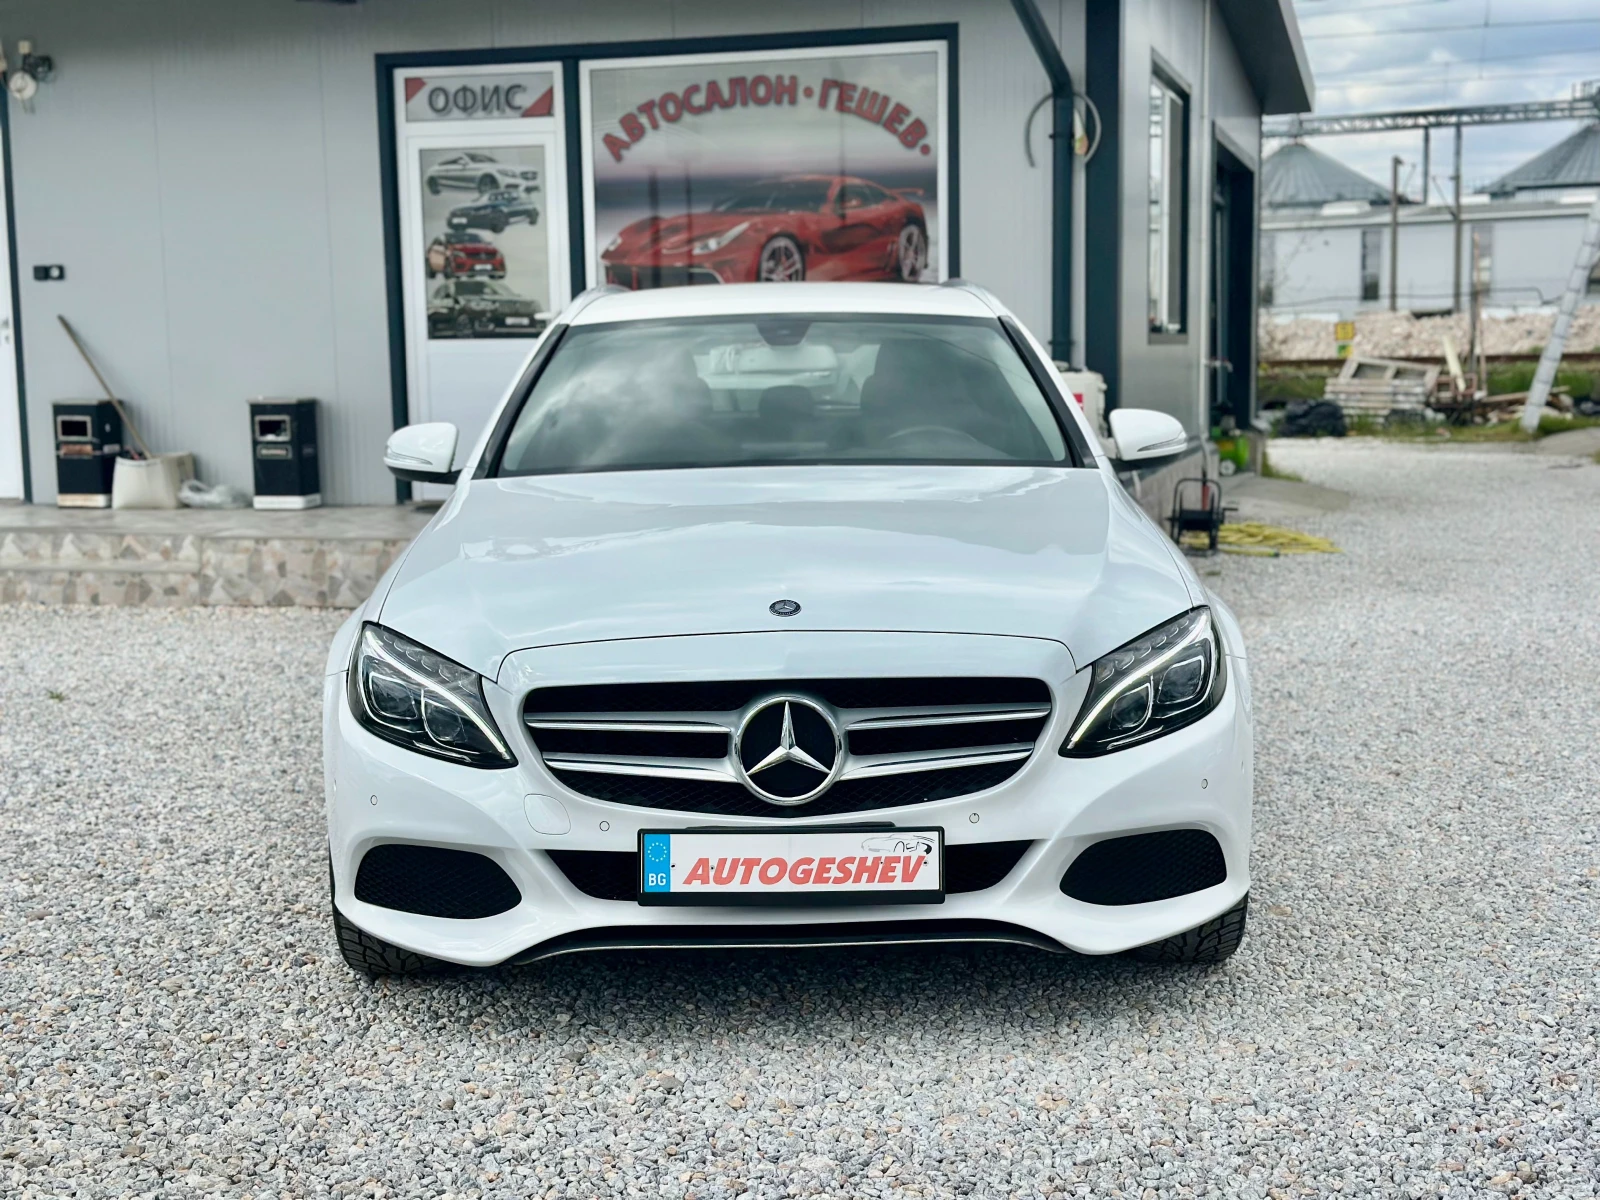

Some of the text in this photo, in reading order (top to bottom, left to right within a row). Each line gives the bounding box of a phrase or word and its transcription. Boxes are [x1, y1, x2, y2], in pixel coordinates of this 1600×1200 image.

[428, 84, 527, 114] ОФИС
[602, 75, 798, 163] АВТОСАЛОН
[648, 872, 667, 887] BG
[682, 855, 926, 886] AUTOGESHEV
